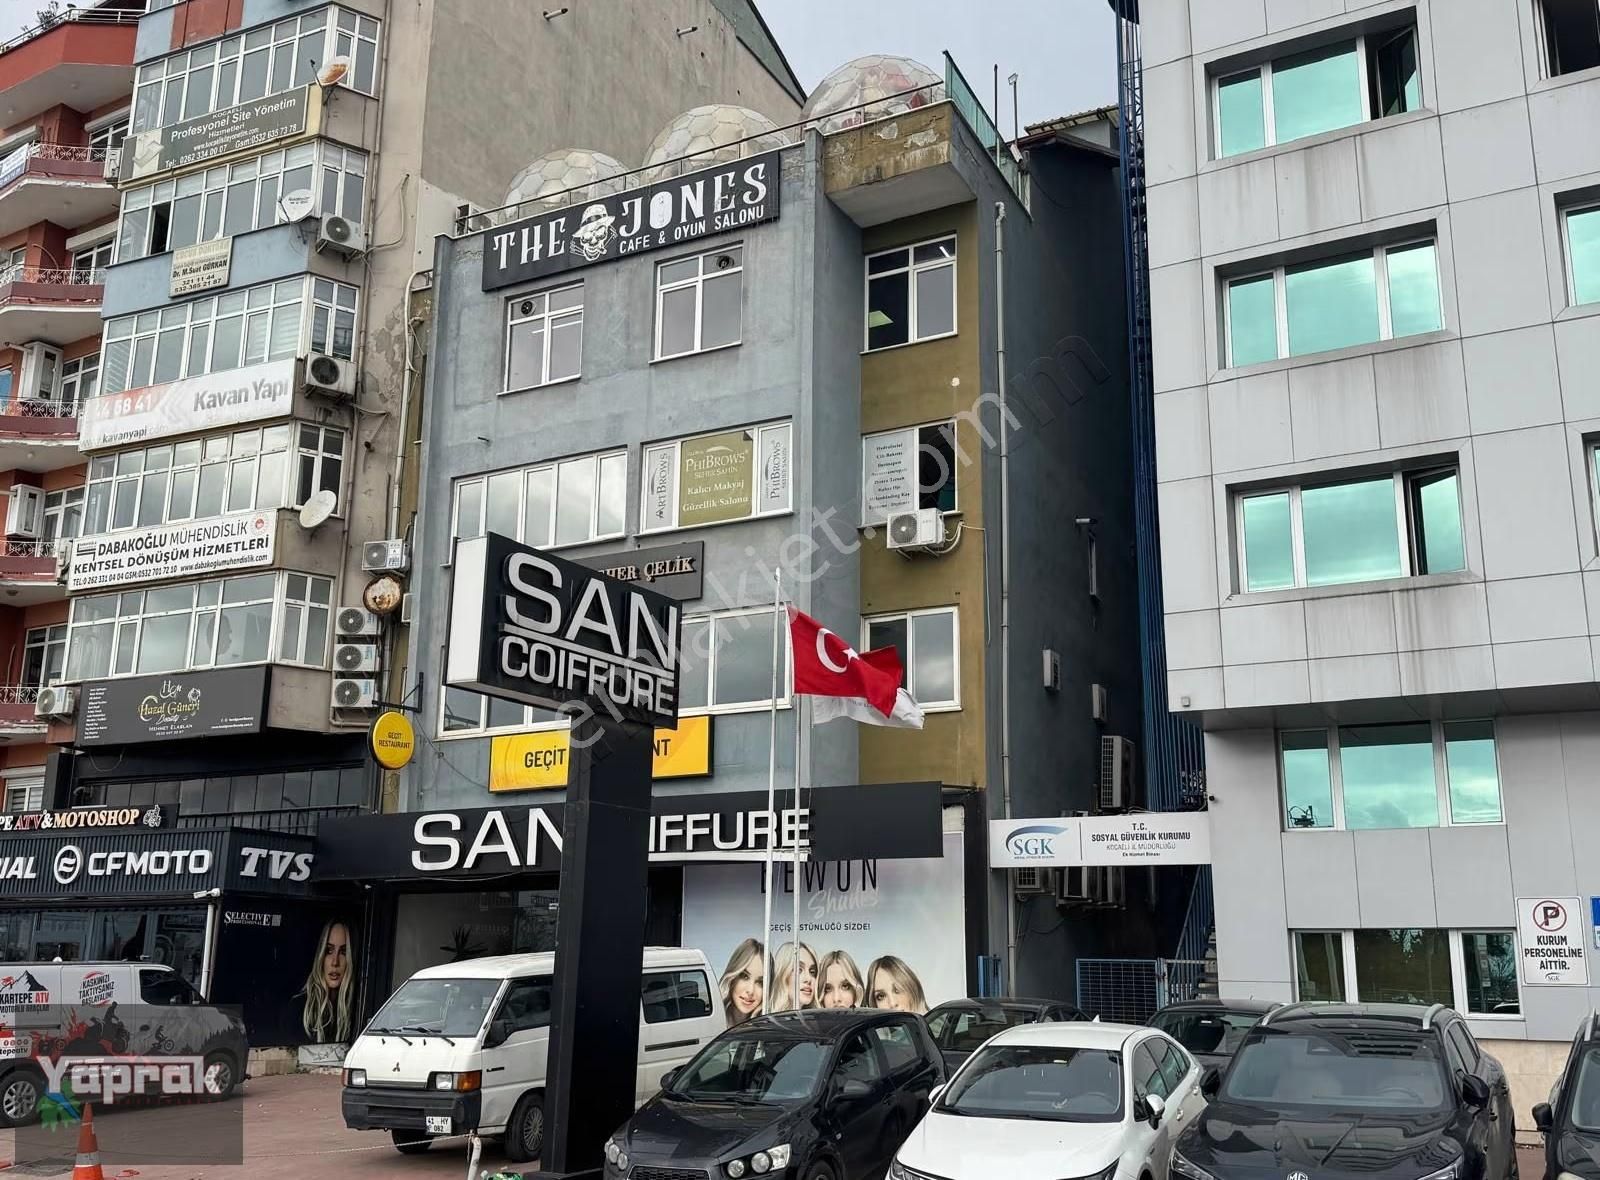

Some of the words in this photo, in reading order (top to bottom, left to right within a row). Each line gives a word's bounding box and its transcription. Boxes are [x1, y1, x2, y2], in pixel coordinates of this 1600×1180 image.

[170, 117, 229, 142] Profesyonel
[232, 112, 252, 124] Site
[254, 98, 296, 116] Yönetim
[208, 122, 245, 138] Hizmetleri
[493, 216, 566, 270] THE
[619, 164, 767, 238] JONES
[620, 234, 650, 254] CAFE
[658, 230, 666, 245] &
[674, 219, 706, 241] OYUN
[714, 204, 764, 231] SALONU
[202, 258, 228, 271] GÜRKAN
[193, 387, 249, 411] Kavan
[252, 378, 289, 402] Yapı
[688, 485, 712, 496] Kalıcı
[714, 480, 744, 492] Makyaj
[682, 499, 717, 512] Güzellik
[719, 496, 749, 508] Salonu
[98, 533, 167, 556] DABAKOĞLU
[169, 520, 248, 546] MÜHENDİSLİK
[74, 559, 124, 575] KENTSEL
[127, 547, 189, 567] DÖNÜŞÜM
[193, 534, 269, 558] HİZMETLERİ
[598, 565, 638, 580] HER
[644, 556, 694, 581] ÇELİK
[504, 552, 676, 670] SAN
[501, 635, 674, 717] COIFFURE
[524, 744, 567, 772] GEÇİT
[412, 808, 563, 871] SAN
[648, 808, 810, 852] IFFURE
[1132, 823, 1147, 831] T.C.
[1014, 838, 1055, 855] SGK
[1092, 833, 1118, 842] SOSYAL
[1120, 831, 1156, 841] GÜVENLİK
[1158, 832, 1190, 840] KURUMU
[0, 856, 36, 878] IAL
[88, 849, 212, 876] CFMOTO
[240, 847, 314, 881] TVS
[224, 911, 270, 926] SELECTIVE
[799, 922, 841, 931] STÜNLÜĞÜ
[844, 922, 871, 931] SİZDE!
[1524, 946, 1583, 958] PERSONELİNE
[1537, 935, 1568, 946] KURUM
[1540, 958, 1570, 970] AİTTİR.
[0, 993, 32, 1004] KARTEPE
[35, 992, 49, 1003] ATV
